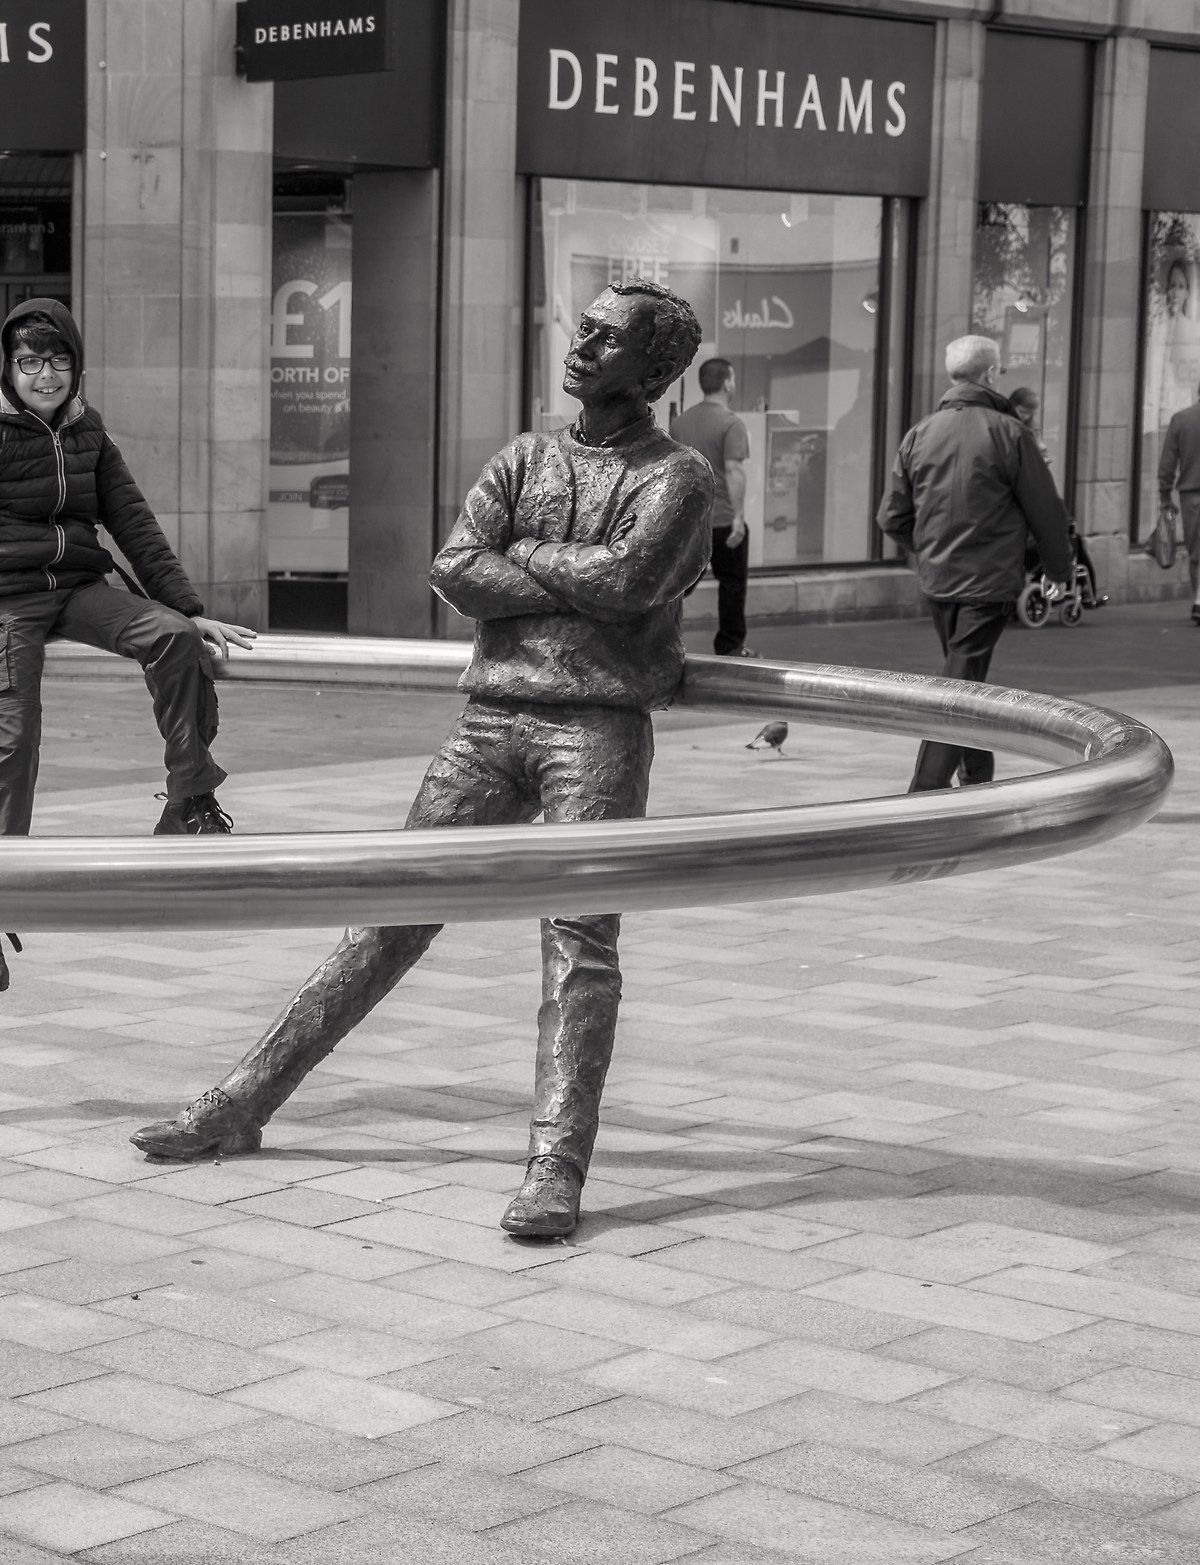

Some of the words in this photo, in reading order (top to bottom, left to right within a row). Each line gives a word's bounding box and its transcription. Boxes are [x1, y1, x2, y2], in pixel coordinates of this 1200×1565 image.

[255, 16, 376, 44] DEBENHAMS
[548, 48, 907, 137] DEBENHAMS
[29, 223, 45, 234] on
[47, 221, 55, 234] 3
[271, 367, 319, 383] ORTH
[295, 391, 314, 401] you
[316, 389, 347, 401] spend
